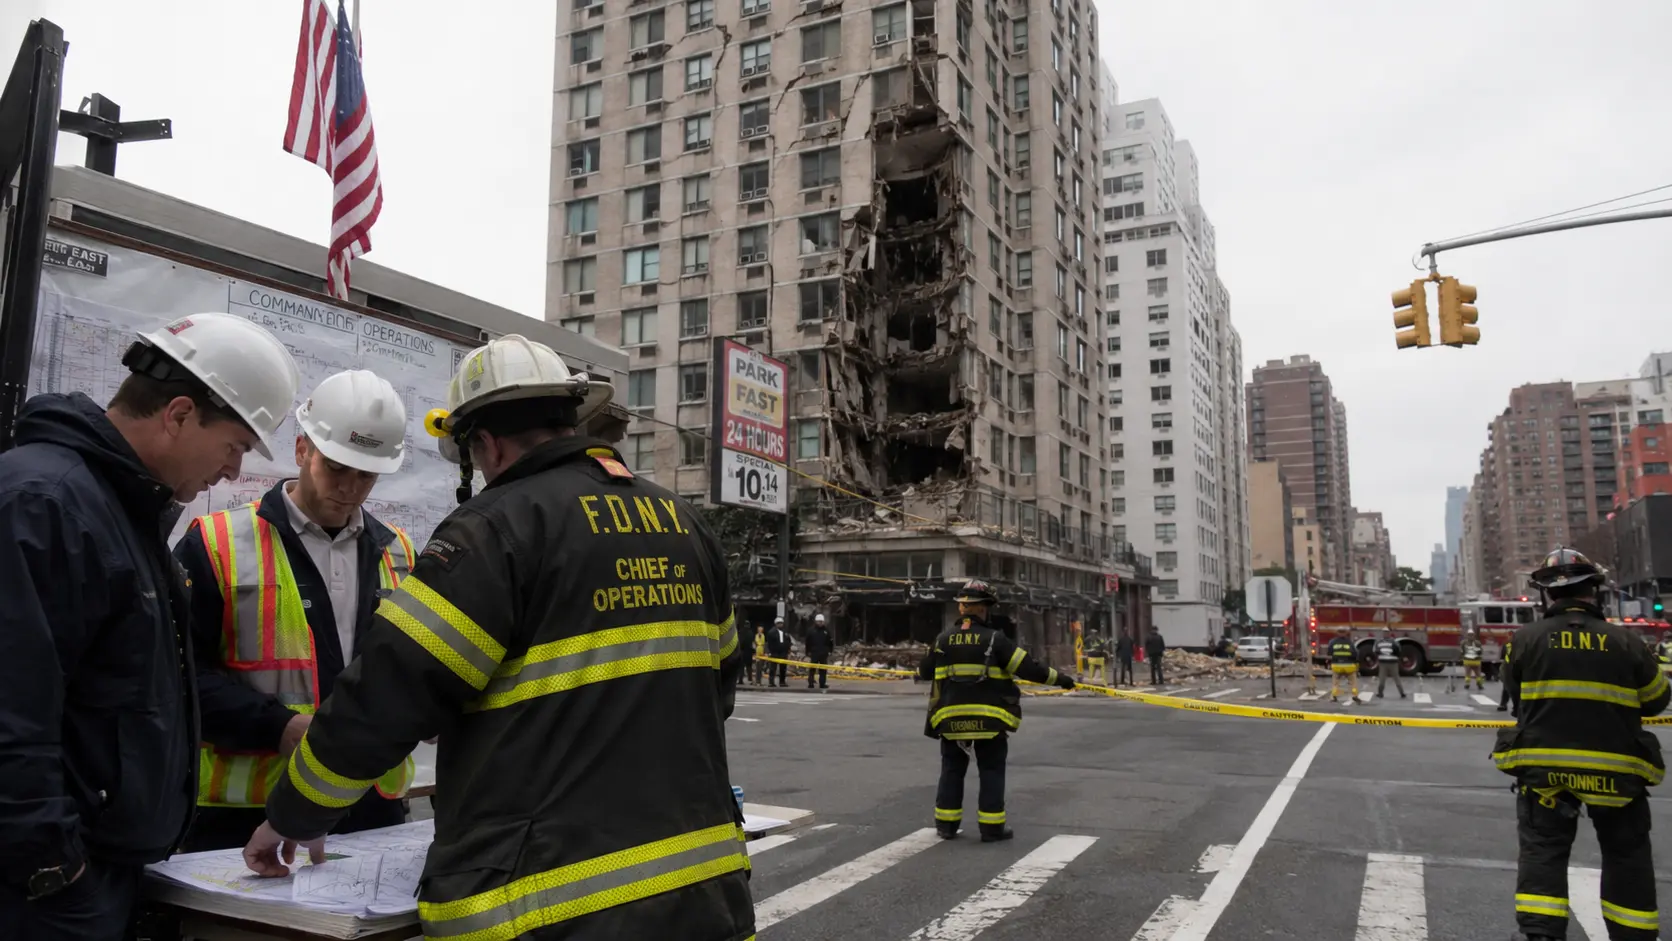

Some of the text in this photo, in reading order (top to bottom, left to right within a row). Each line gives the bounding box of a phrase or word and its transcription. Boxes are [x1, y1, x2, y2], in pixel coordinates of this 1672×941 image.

[72, 247, 106, 265] EAST
[363, 321, 435, 354] OPERATIONS
[736, 357, 778, 388] PARK
[736, 383, 778, 413] FAST
[727, 419, 784, 457] 24 HOURS
[736, 454, 776, 472] SPECIAL
[578, 494, 689, 534] F.D.N.Y.
[615, 556, 686, 580] CHIEF OF
[593, 583, 704, 612] OPERATIONS
[949, 633, 981, 646] F.D.N.Y.
[1262, 711, 1305, 720] CAUTION
[1354, 718, 1402, 727] CAUTION
[1547, 771, 1619, 794] O'CONNELL
